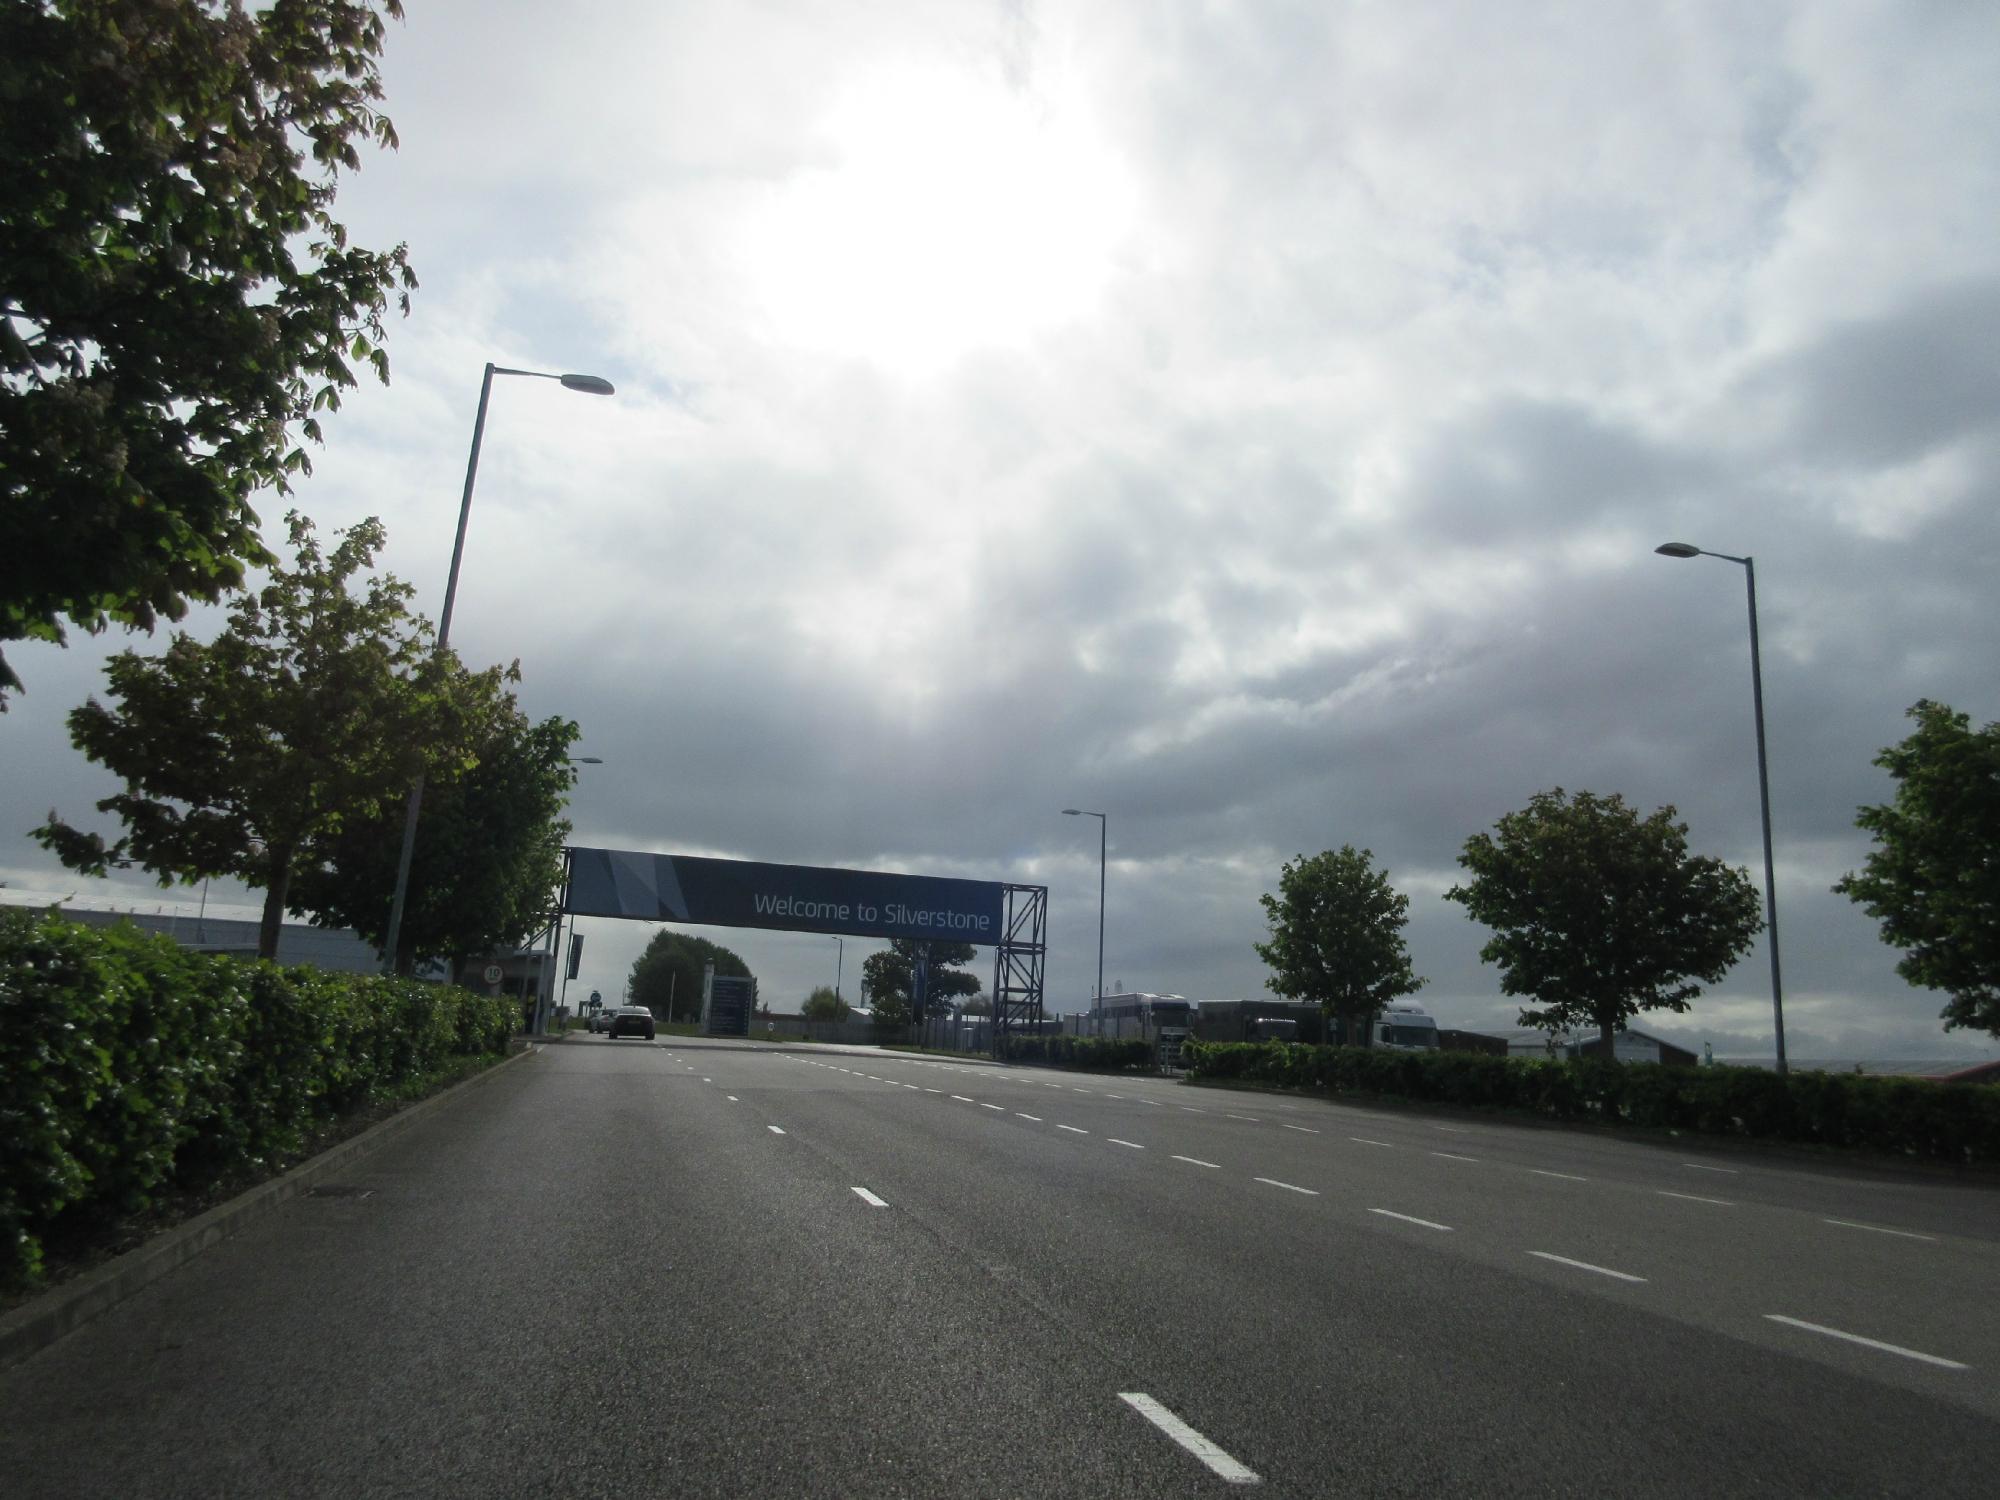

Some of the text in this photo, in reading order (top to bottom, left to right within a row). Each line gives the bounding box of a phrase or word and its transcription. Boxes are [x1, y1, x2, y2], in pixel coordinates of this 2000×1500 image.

[754, 893, 990, 931] Welcome to Silverstone
[488, 968, 500, 977] 10
